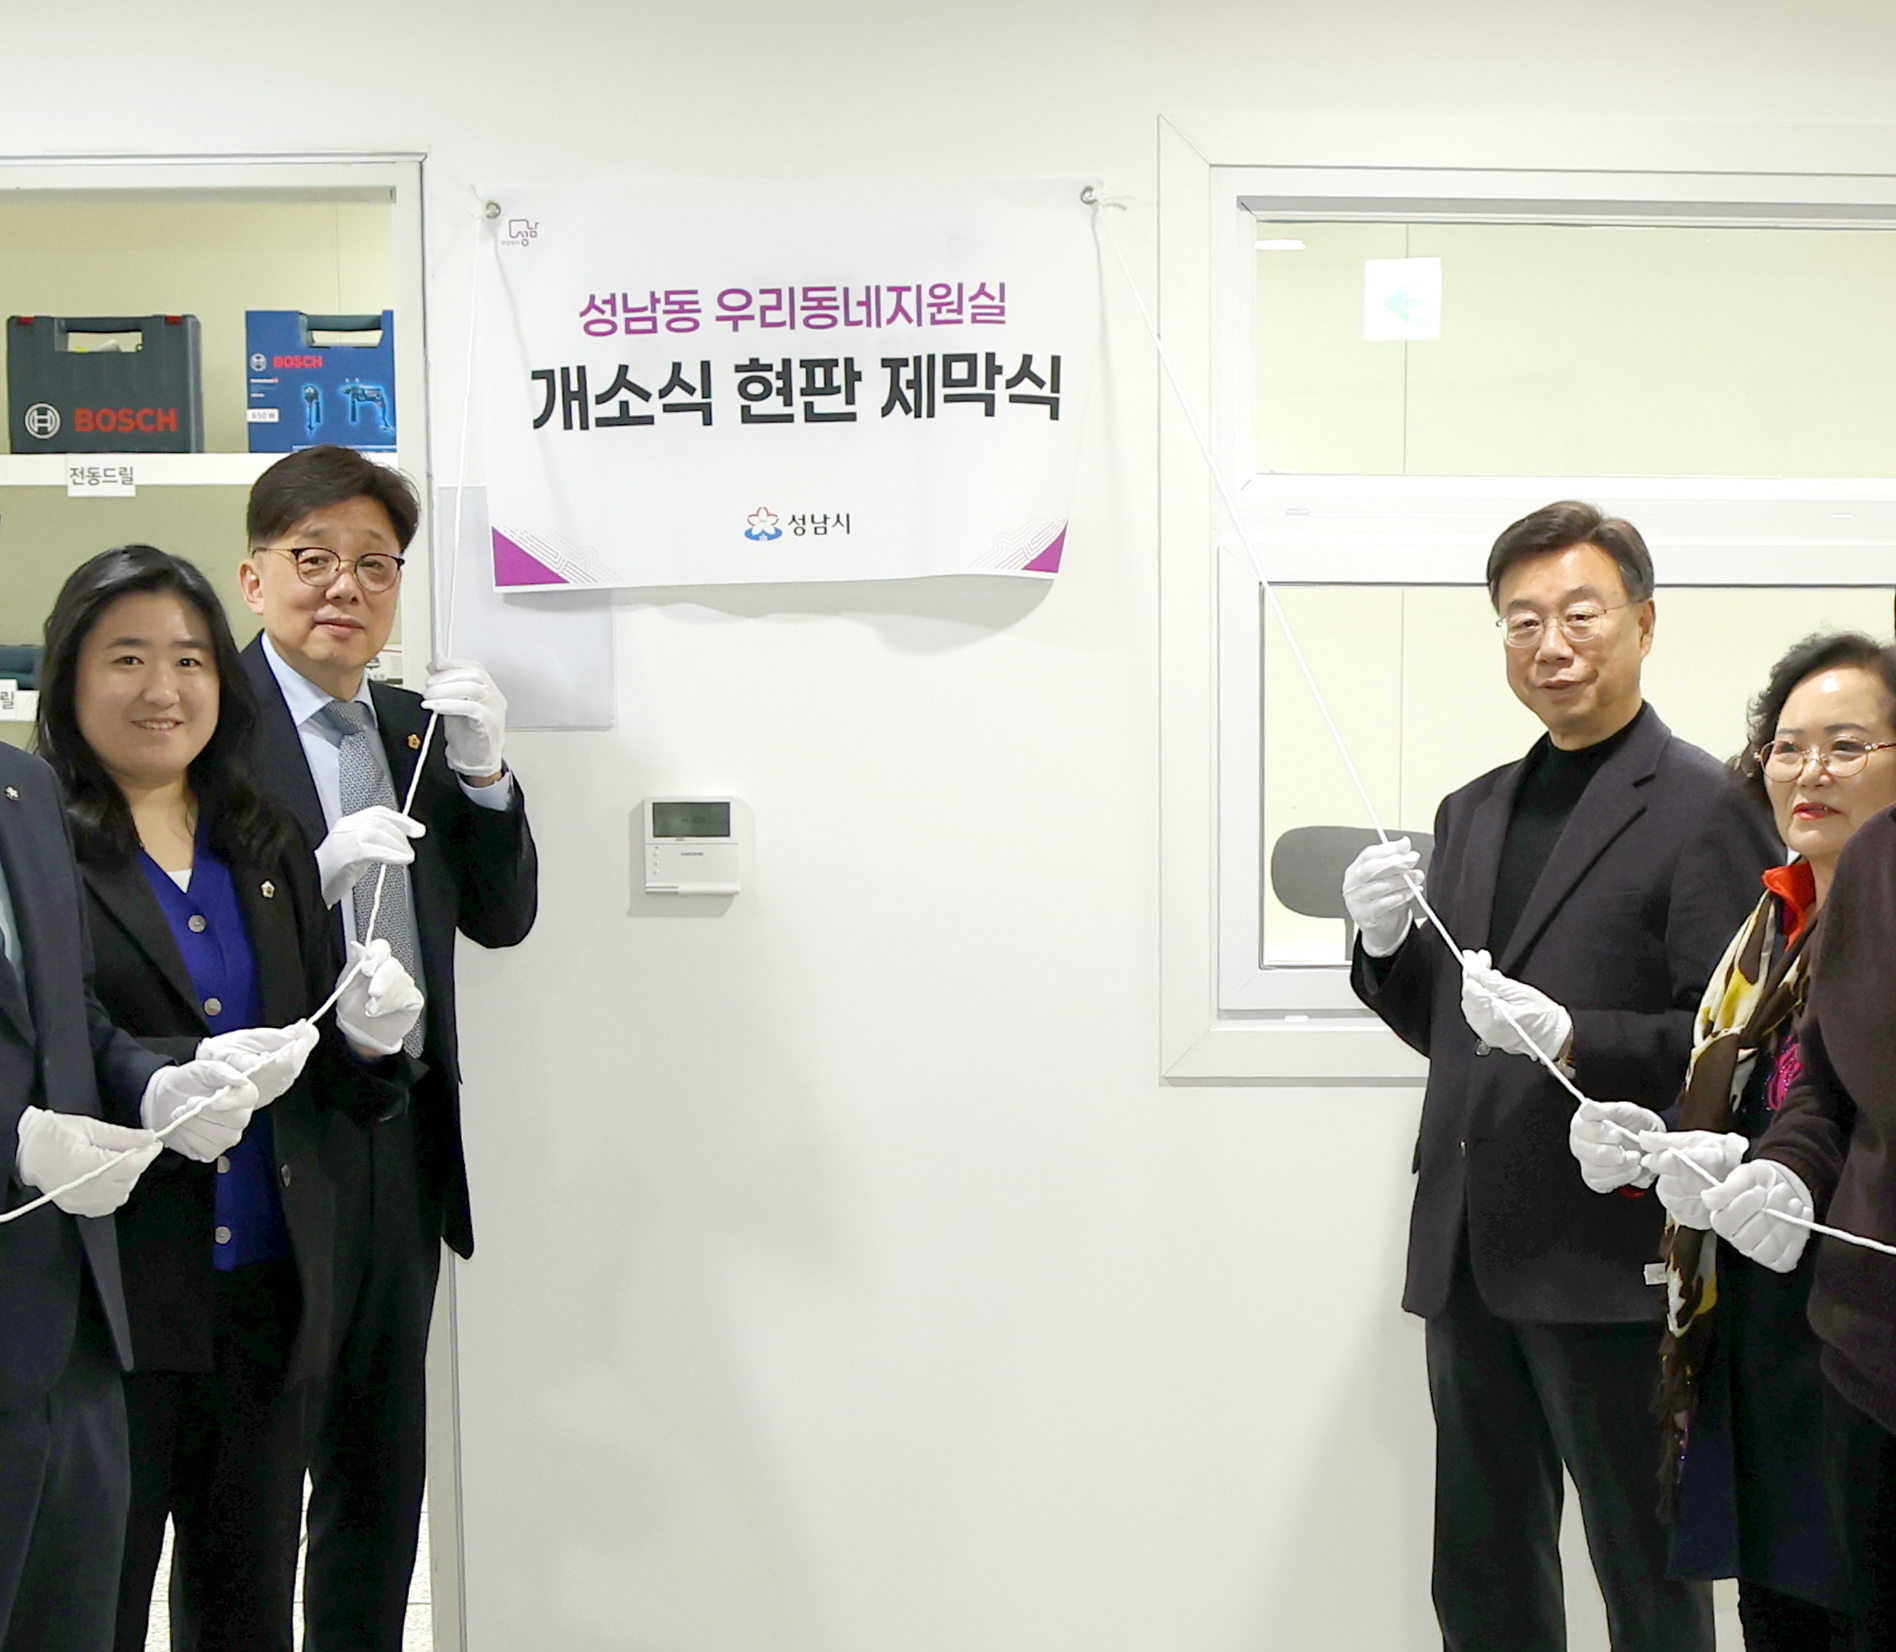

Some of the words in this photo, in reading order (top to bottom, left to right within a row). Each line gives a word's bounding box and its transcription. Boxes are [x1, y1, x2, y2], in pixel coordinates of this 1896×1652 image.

[579, 288, 702, 337] 성남동
[715, 282, 1006, 332] 우리동네지원실
[273, 355, 323, 369] BOSCH
[531, 359, 714, 431] 개소식
[733, 356, 862, 425] 현판
[880, 351, 1062, 422] 제막식
[74, 407, 178, 433] BOSCH
[69, 466, 134, 486] 전동드릴
[787, 512, 851, 537] 성남시
